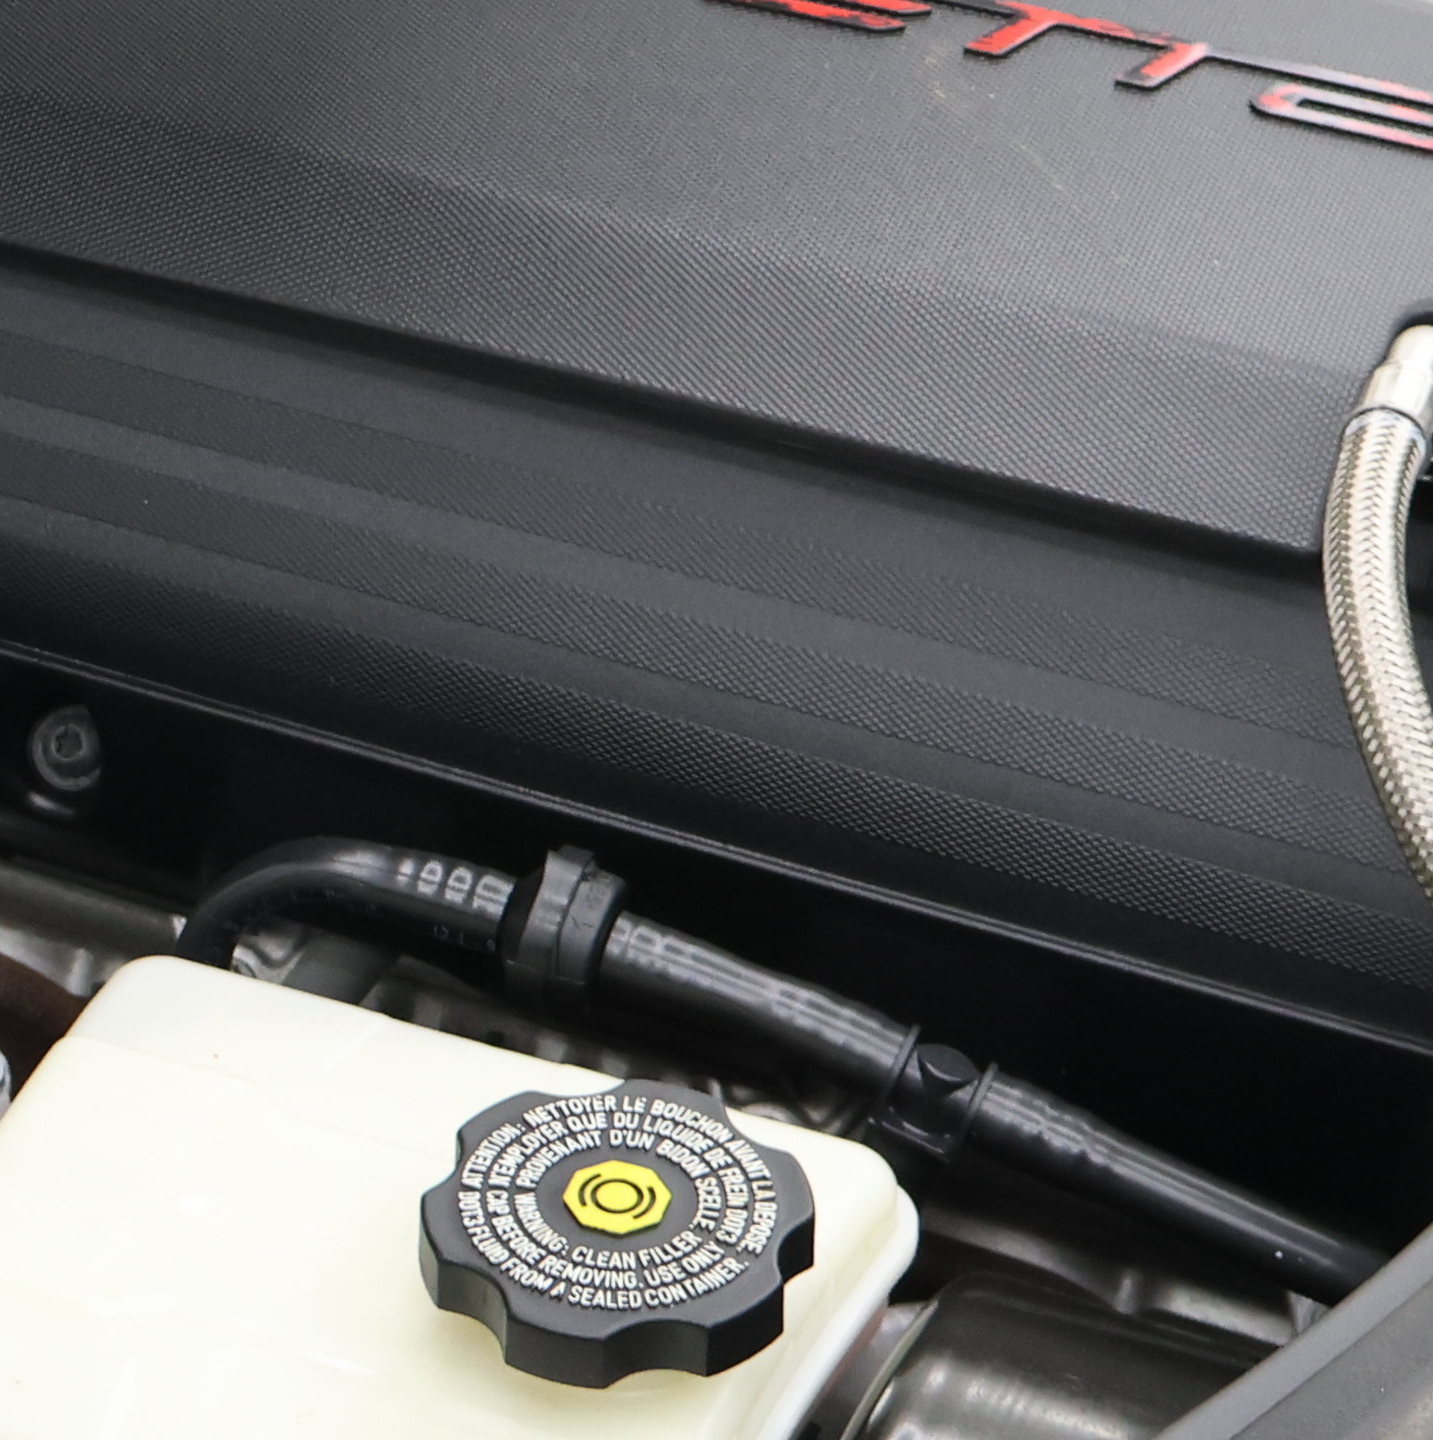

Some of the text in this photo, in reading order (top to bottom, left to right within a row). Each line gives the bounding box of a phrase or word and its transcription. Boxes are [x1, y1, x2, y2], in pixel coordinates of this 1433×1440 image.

[565, 1111, 608, 1133] QUE
[612, 1111, 640, 1131] DU
[642, 1114, 716, 1155] LIQUIDE
[460, 1122, 527, 1190] ATTENTION:
[522, 1094, 618, 1128] NETTOYER
[622, 1095, 648, 1114] LE
[650, 1099, 734, 1144] BOUCHON
[723, 1139, 773, 1180] AVANT
[751, 1180, 777, 1201] LA
[515, 1129, 602, 1189] PROVENANT
[609, 1129, 656, 1151] D'UN
[655, 1138, 712, 1179] BIDON
[702, 1146, 734, 1171] DE
[485, 1189, 511, 1216] CAP
[717, 1166, 750, 1209] FREIN
[491, 1213, 548, 1266] BEFORE
[514, 1191, 704, 1271] WARNING: CLEAN FILLER
[466, 1224, 511, 1265] FLUID
[499, 1256, 555, 1293] FROM
[549, 1281, 567, 1300] A
[567, 1284, 644, 1310] SEALED
[642, 1261, 687, 1288] USE
[681, 1239, 726, 1275] ONLY
